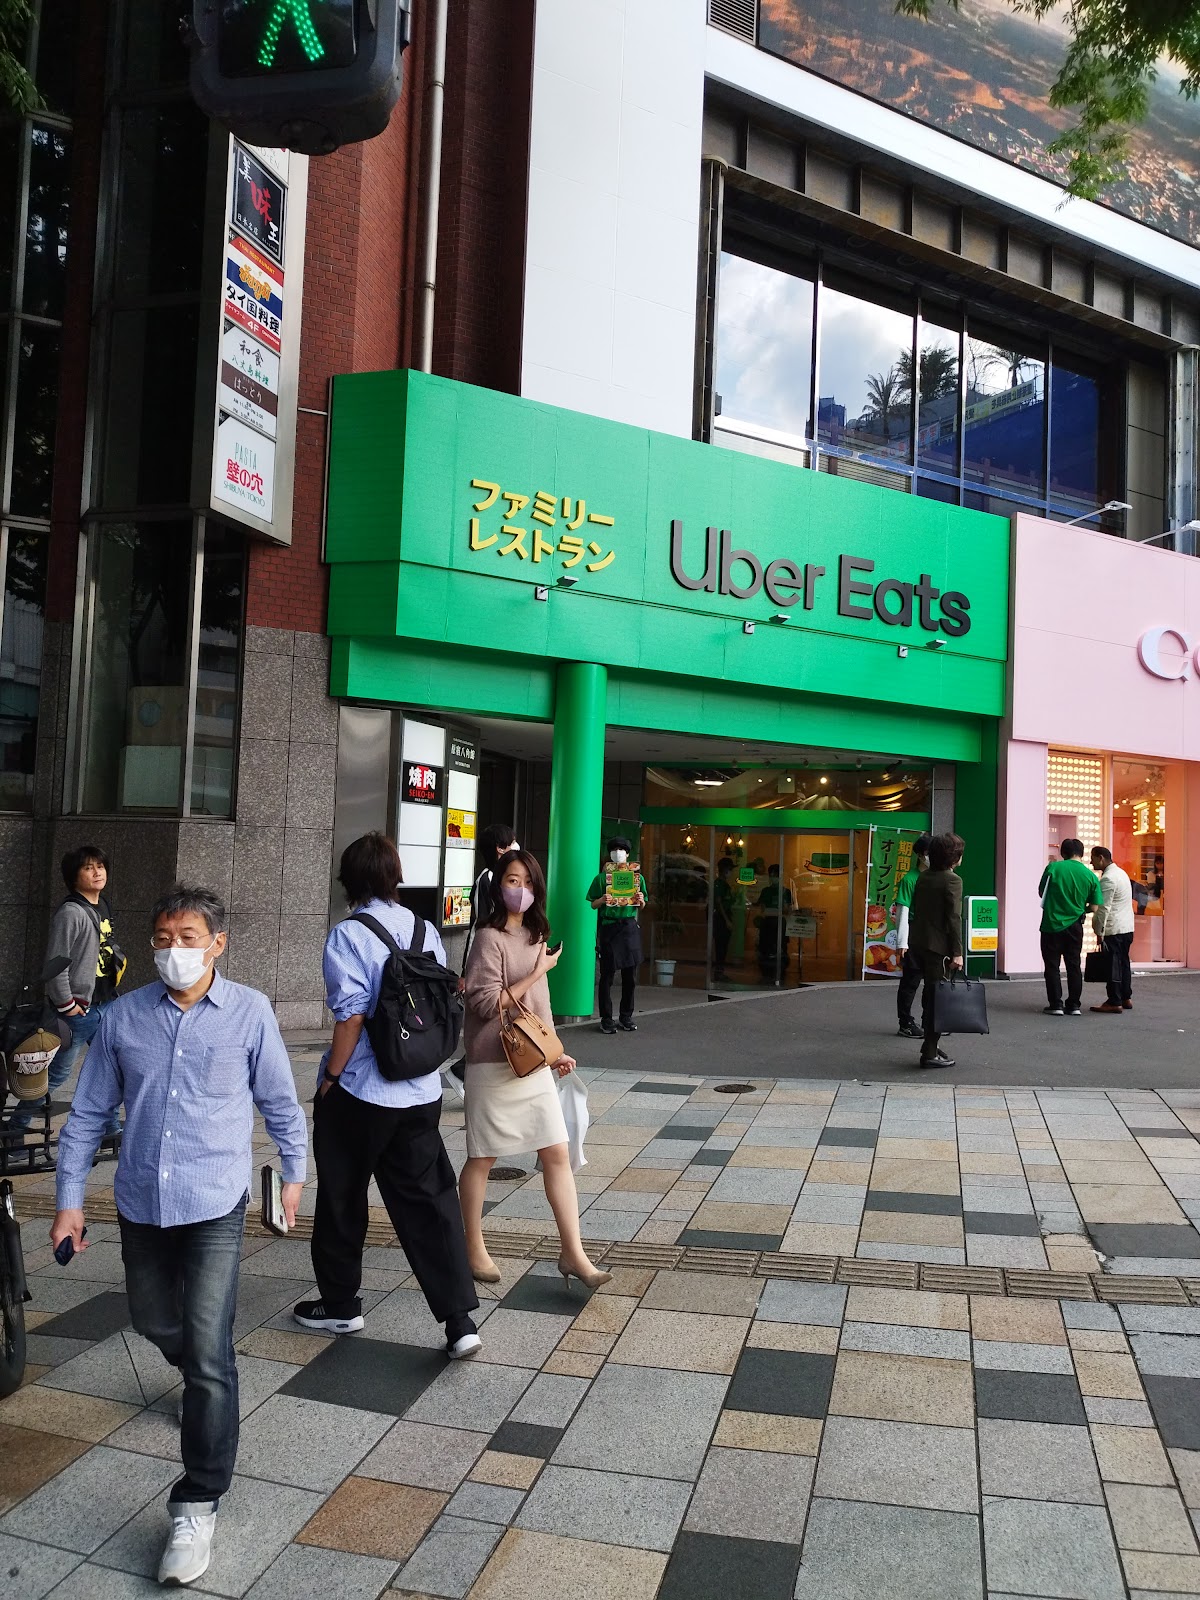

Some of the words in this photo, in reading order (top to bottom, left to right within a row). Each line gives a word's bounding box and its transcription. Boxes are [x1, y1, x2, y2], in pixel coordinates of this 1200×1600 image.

[226, 284, 280, 335] タイ国料理
[247, 320, 260, 332] 4F
[239, 340, 264, 368] 和食
[233, 376, 262, 404] はっとり
[235, 442, 258, 471] PASTA
[226, 458, 263, 496] 壁の穴
[471, 478, 615, 530] ファミリー
[469, 517, 616, 572] レストラン
[670, 519, 826, 611] Uber
[837, 554, 971, 637] Eats
[408, 766, 436, 789] 焼肉
[409, 789, 434, 799] SEIKO-EN
[976, 906, 992, 914] Uber
[976, 914, 993, 923] Eats
